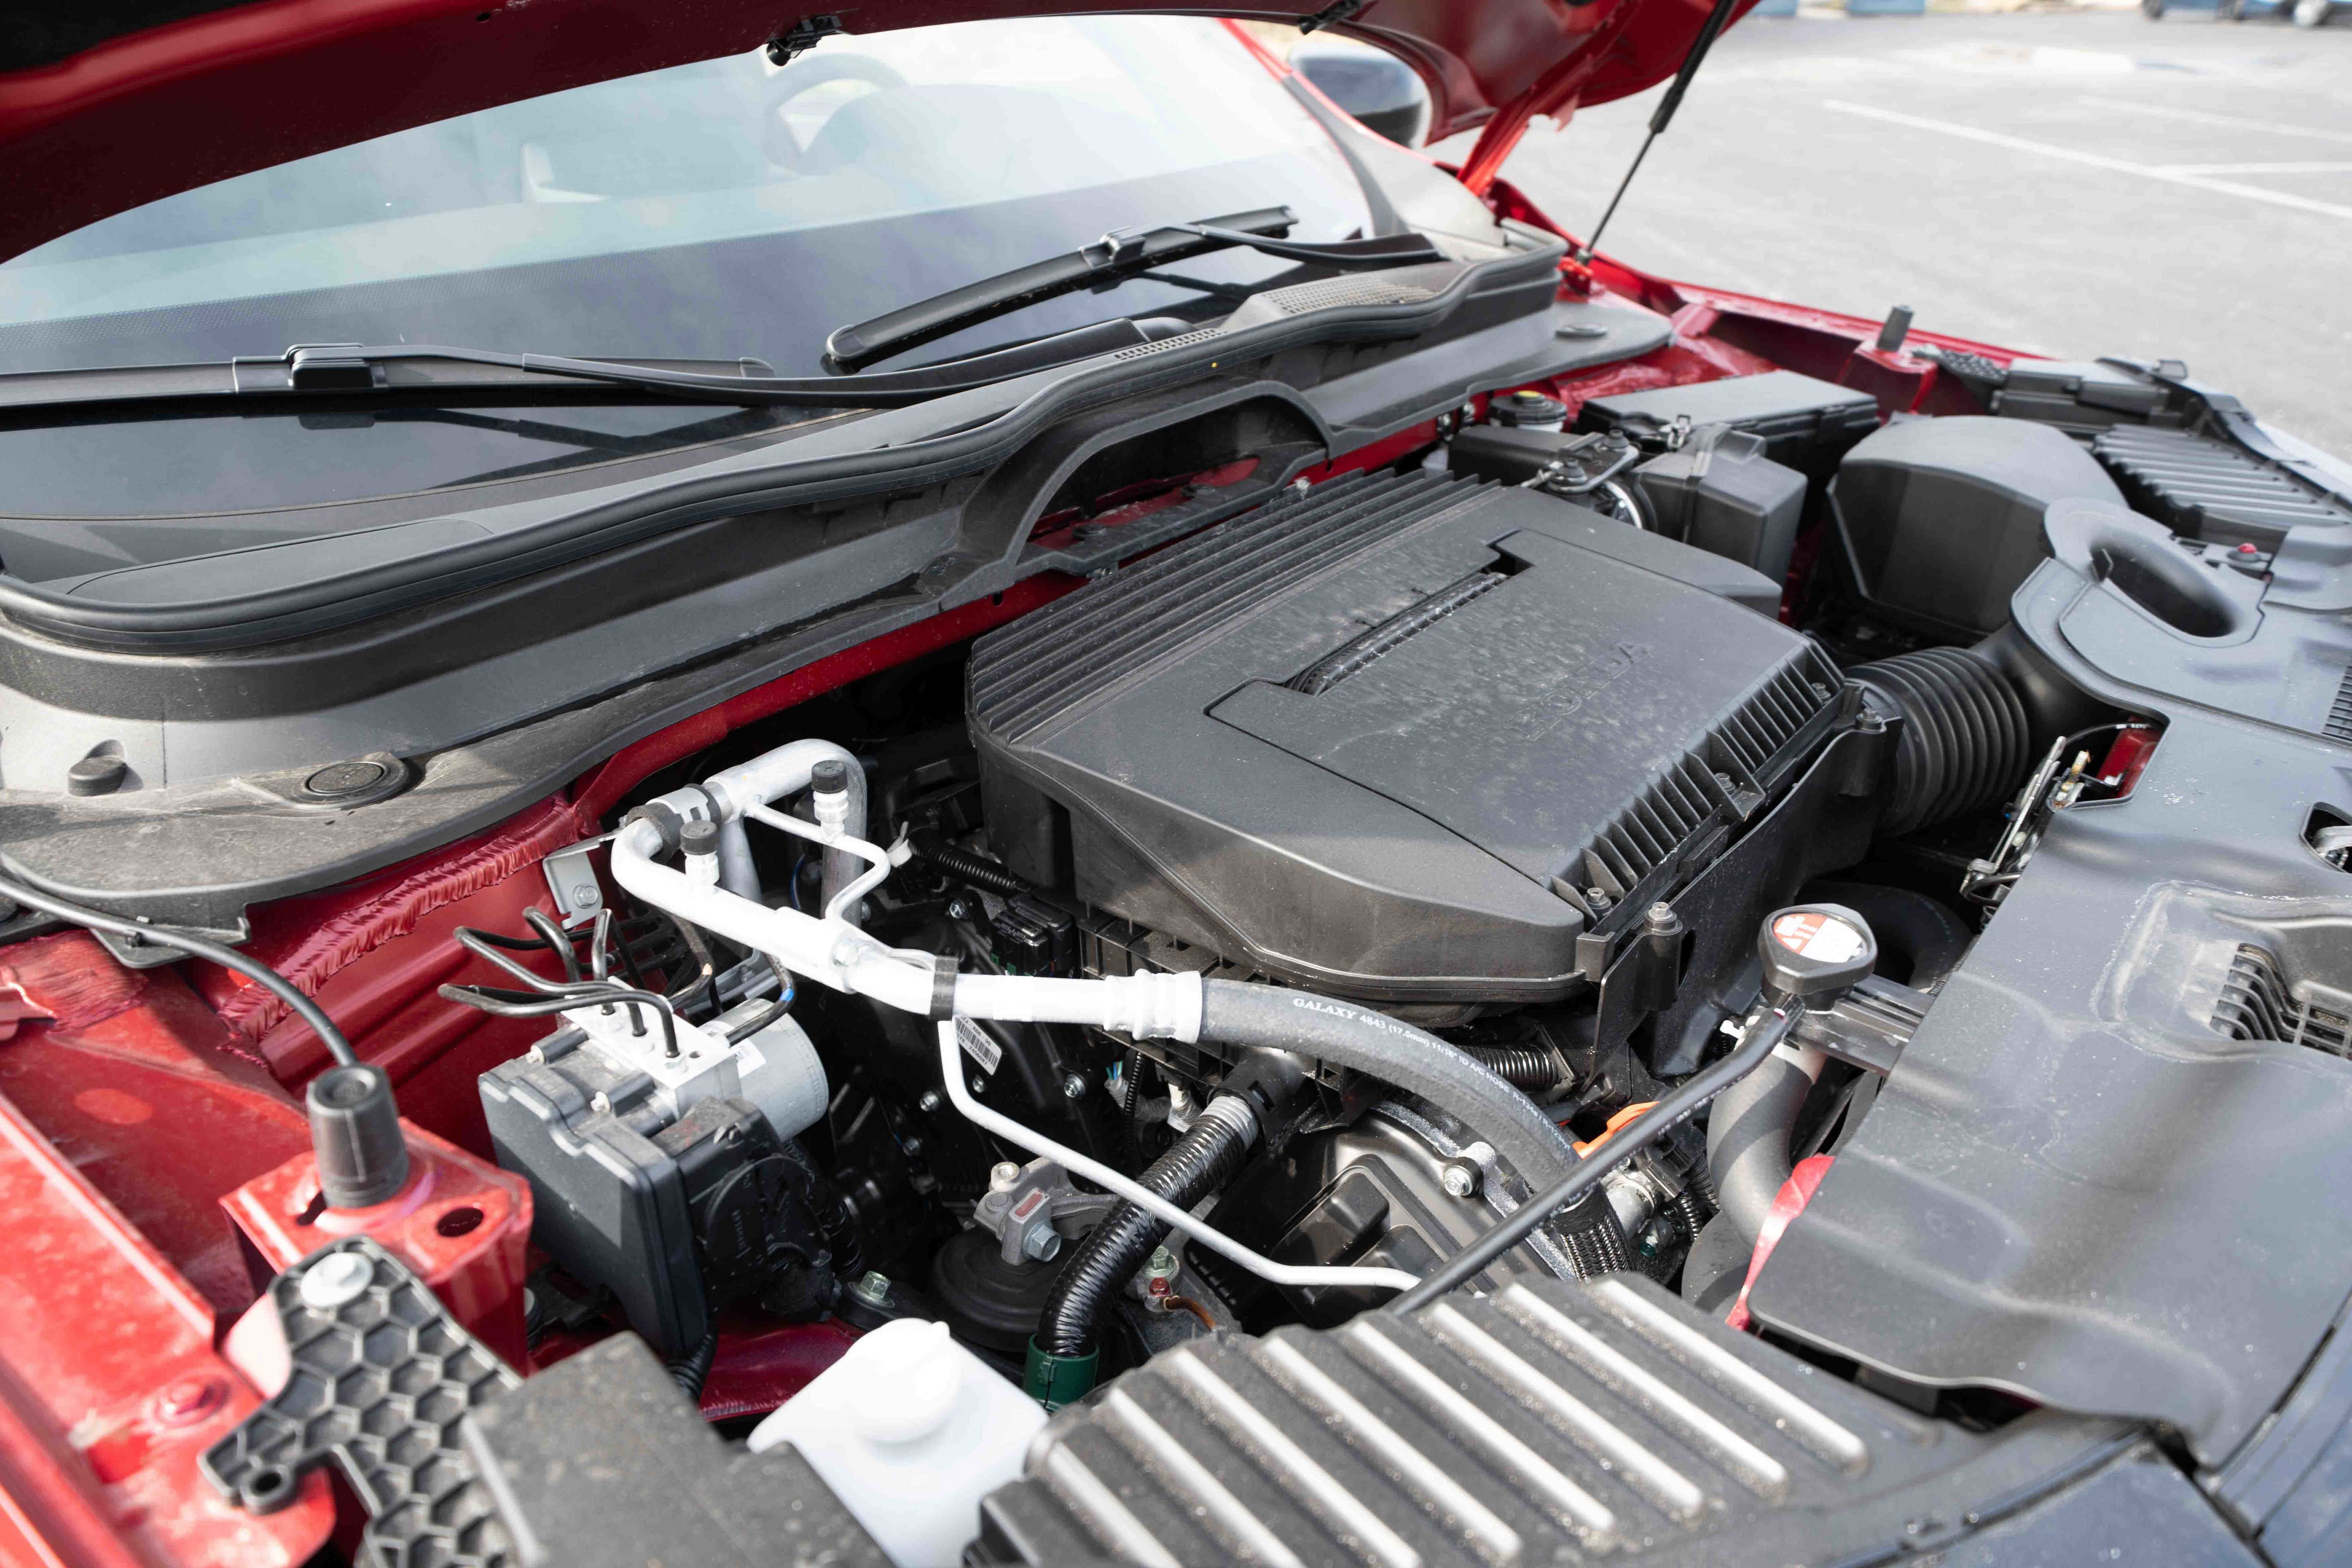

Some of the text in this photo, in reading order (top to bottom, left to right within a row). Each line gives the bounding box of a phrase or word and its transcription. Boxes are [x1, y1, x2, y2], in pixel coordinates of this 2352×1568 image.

[1293, 998, 1358, 1020] GALAXY
[1359, 1014, 1386, 1030] 4843
[1459, 1055, 1469, 1066] ID
[1486, 1072, 1510, 1093] HOSE
